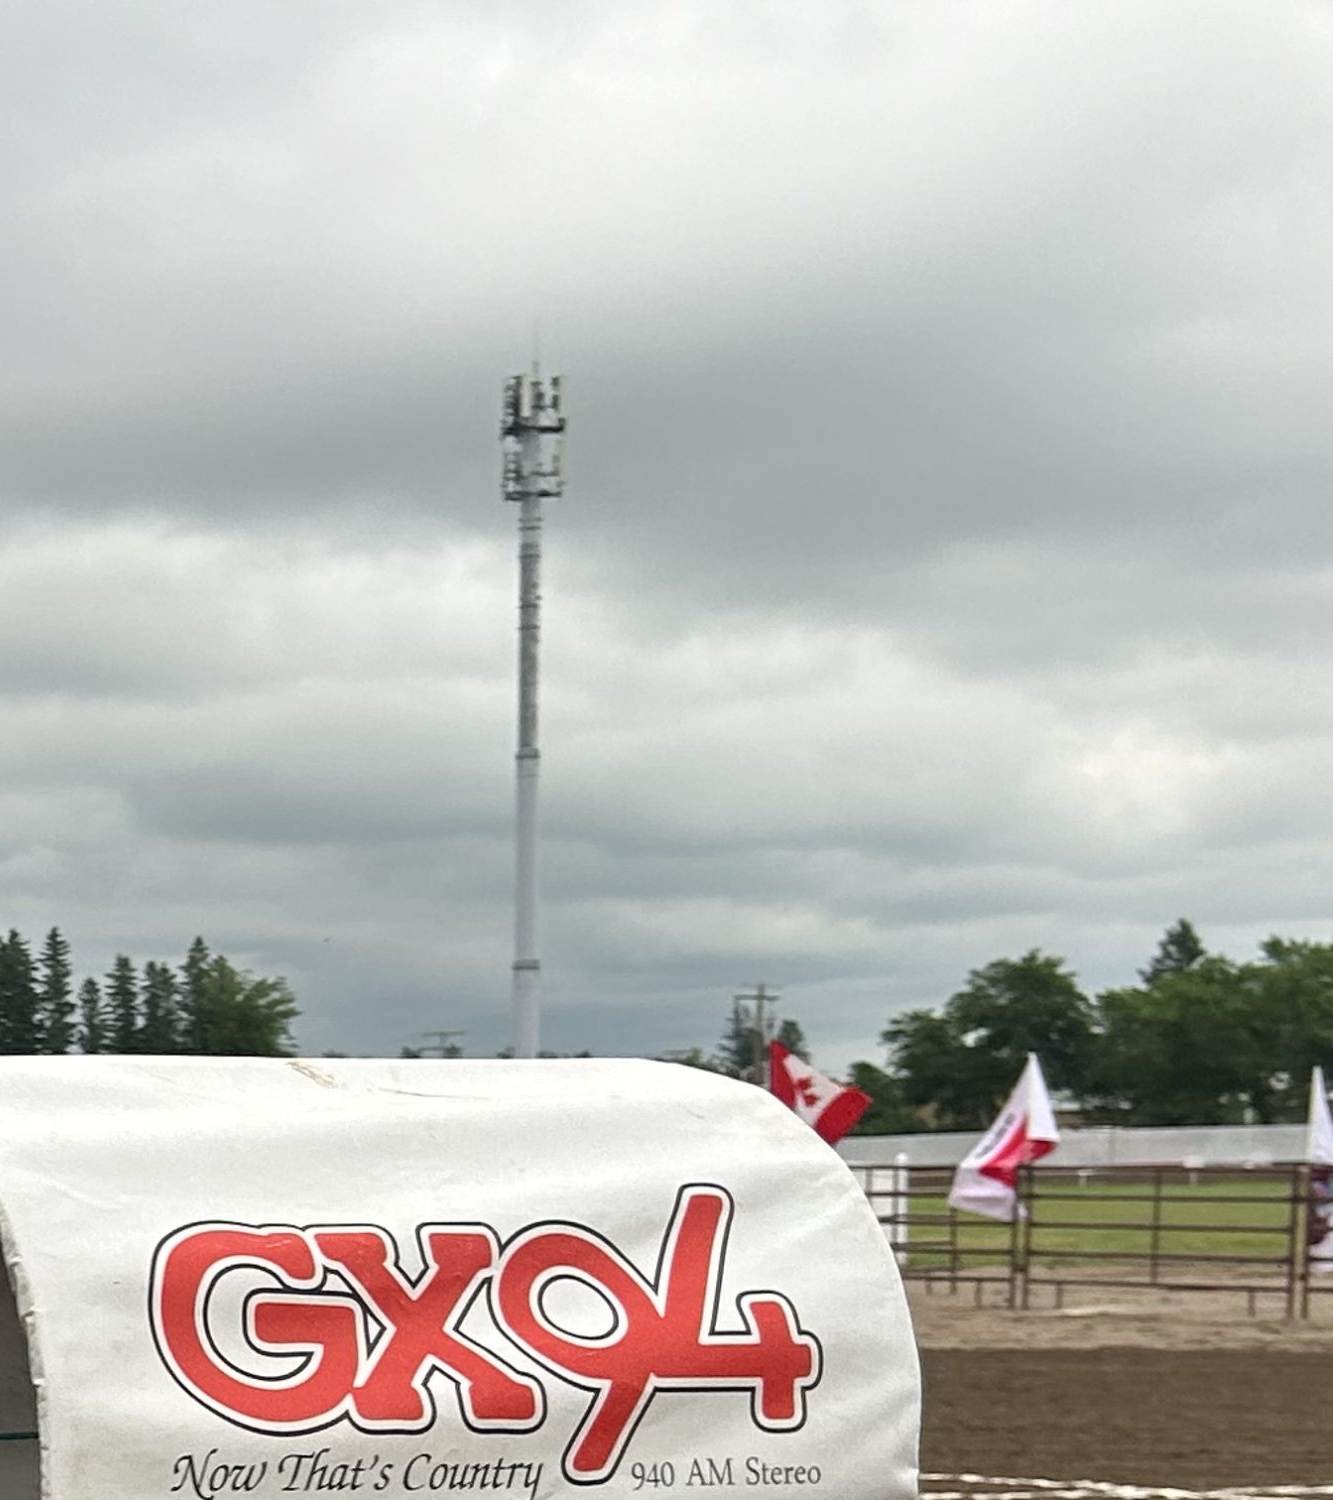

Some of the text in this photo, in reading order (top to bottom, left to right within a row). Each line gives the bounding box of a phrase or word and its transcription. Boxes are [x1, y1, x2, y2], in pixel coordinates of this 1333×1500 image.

[149, 1183, 822, 1485] GX94
[171, 1453, 267, 1495] Now
[276, 1452, 391, 1494] That's
[631, 1456, 822, 1491] 940 AM Stereo
